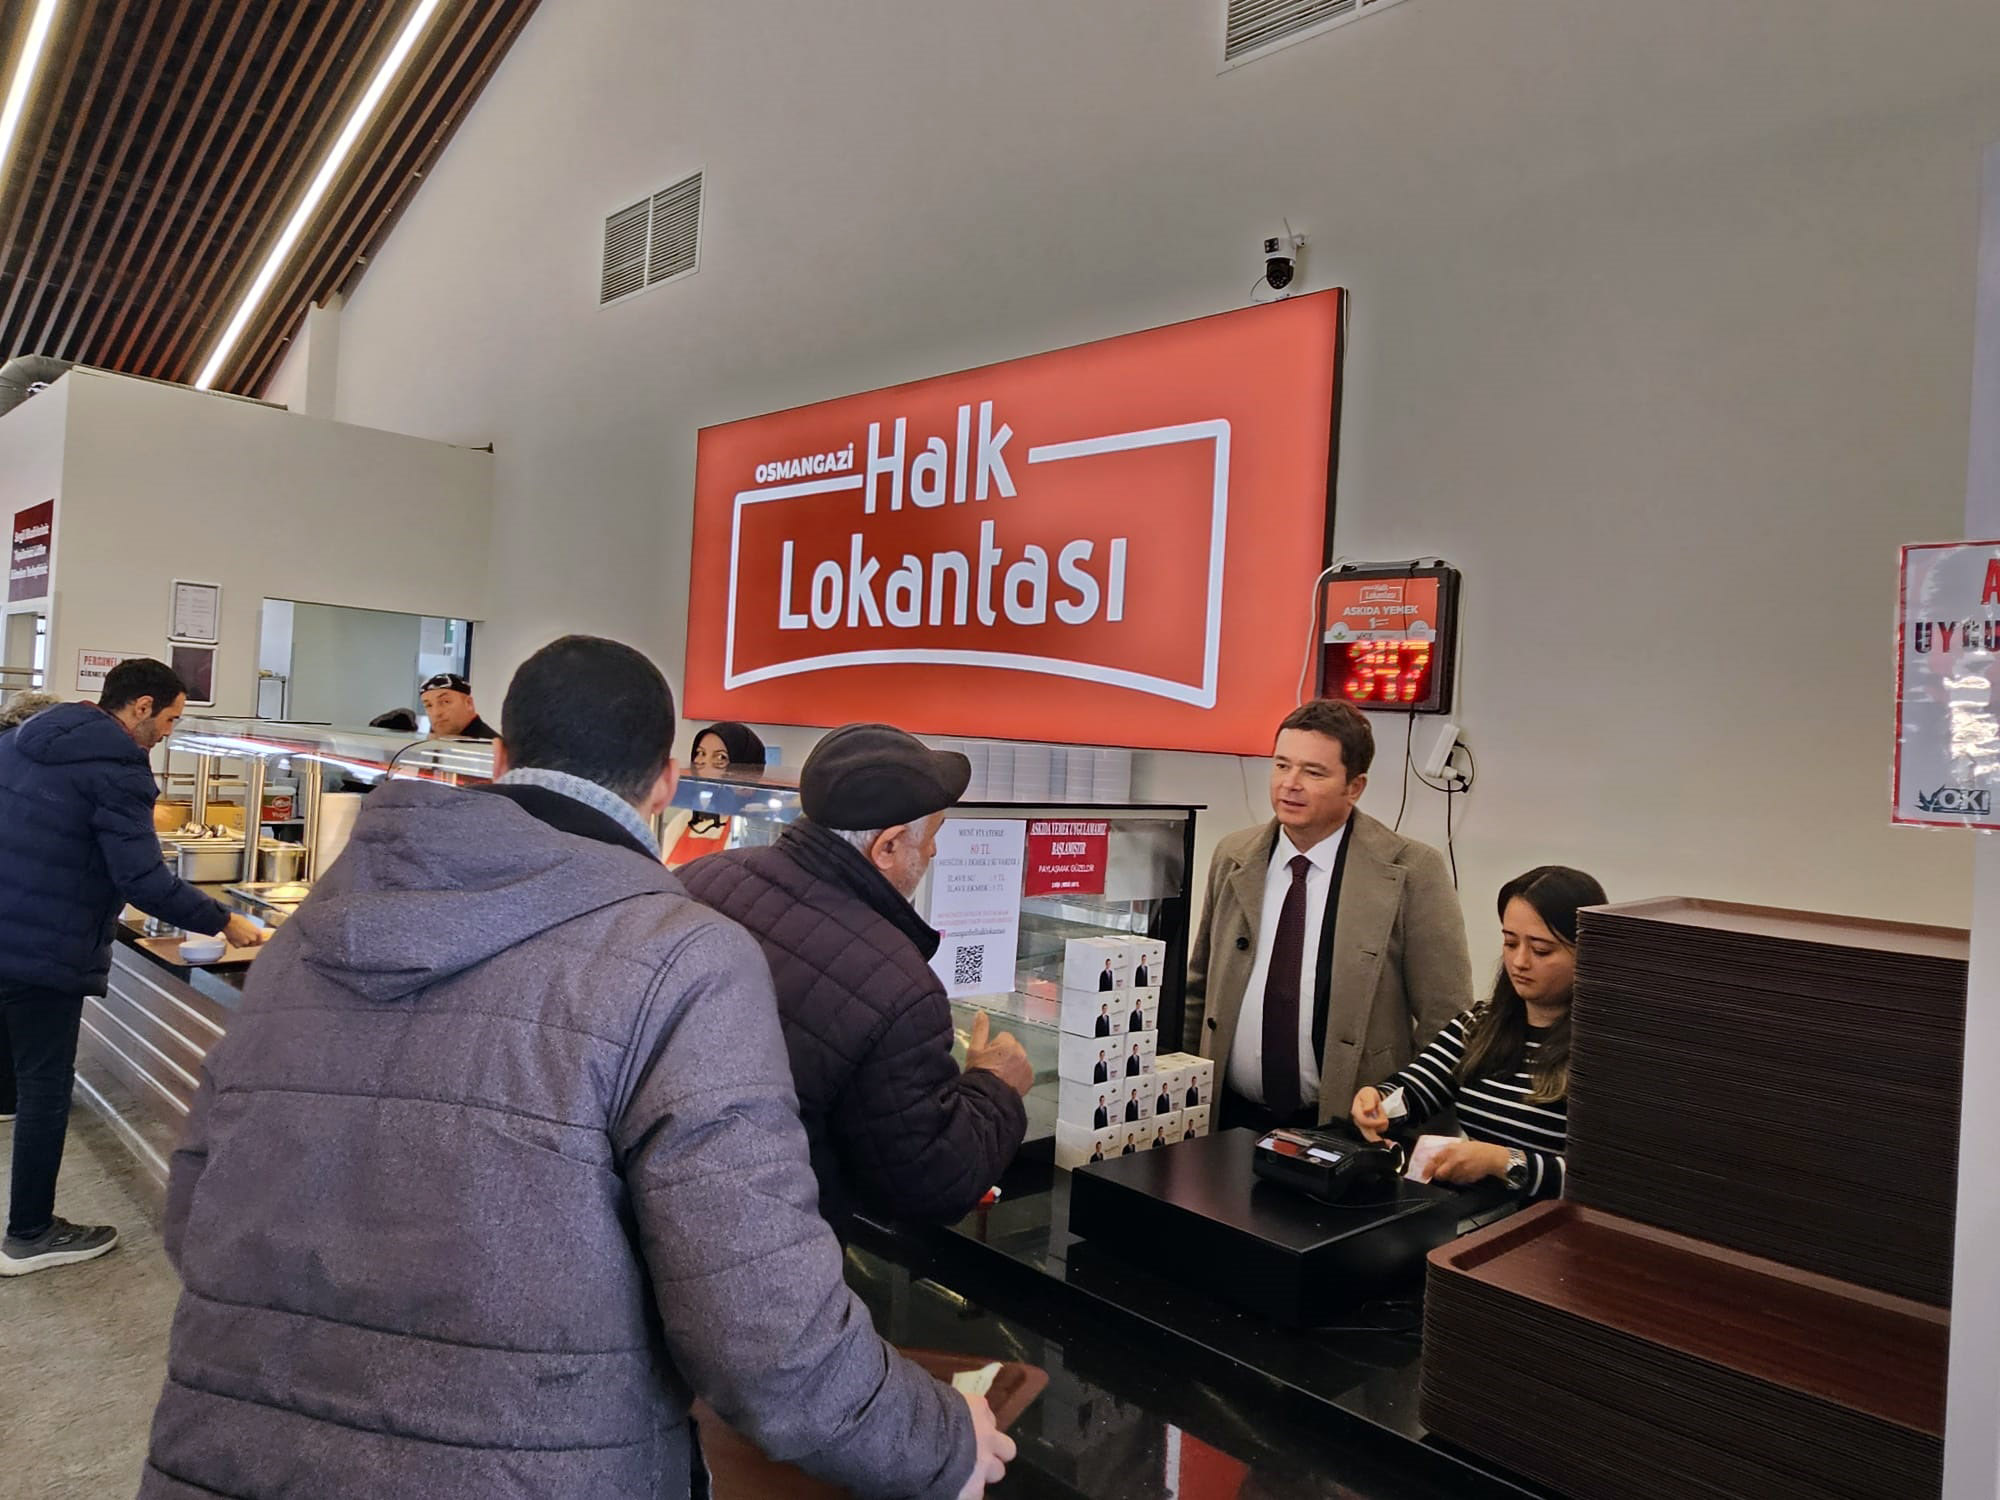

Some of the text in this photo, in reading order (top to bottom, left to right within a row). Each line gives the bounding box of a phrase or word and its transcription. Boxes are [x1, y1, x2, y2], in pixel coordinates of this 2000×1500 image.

[754, 442, 855, 483] OSMANGAZİ
[864, 401, 1017, 514] Halk
[779, 520, 1127, 630] Lokantası
[1343, 604, 1418, 616] ASKIDA YEMEK
